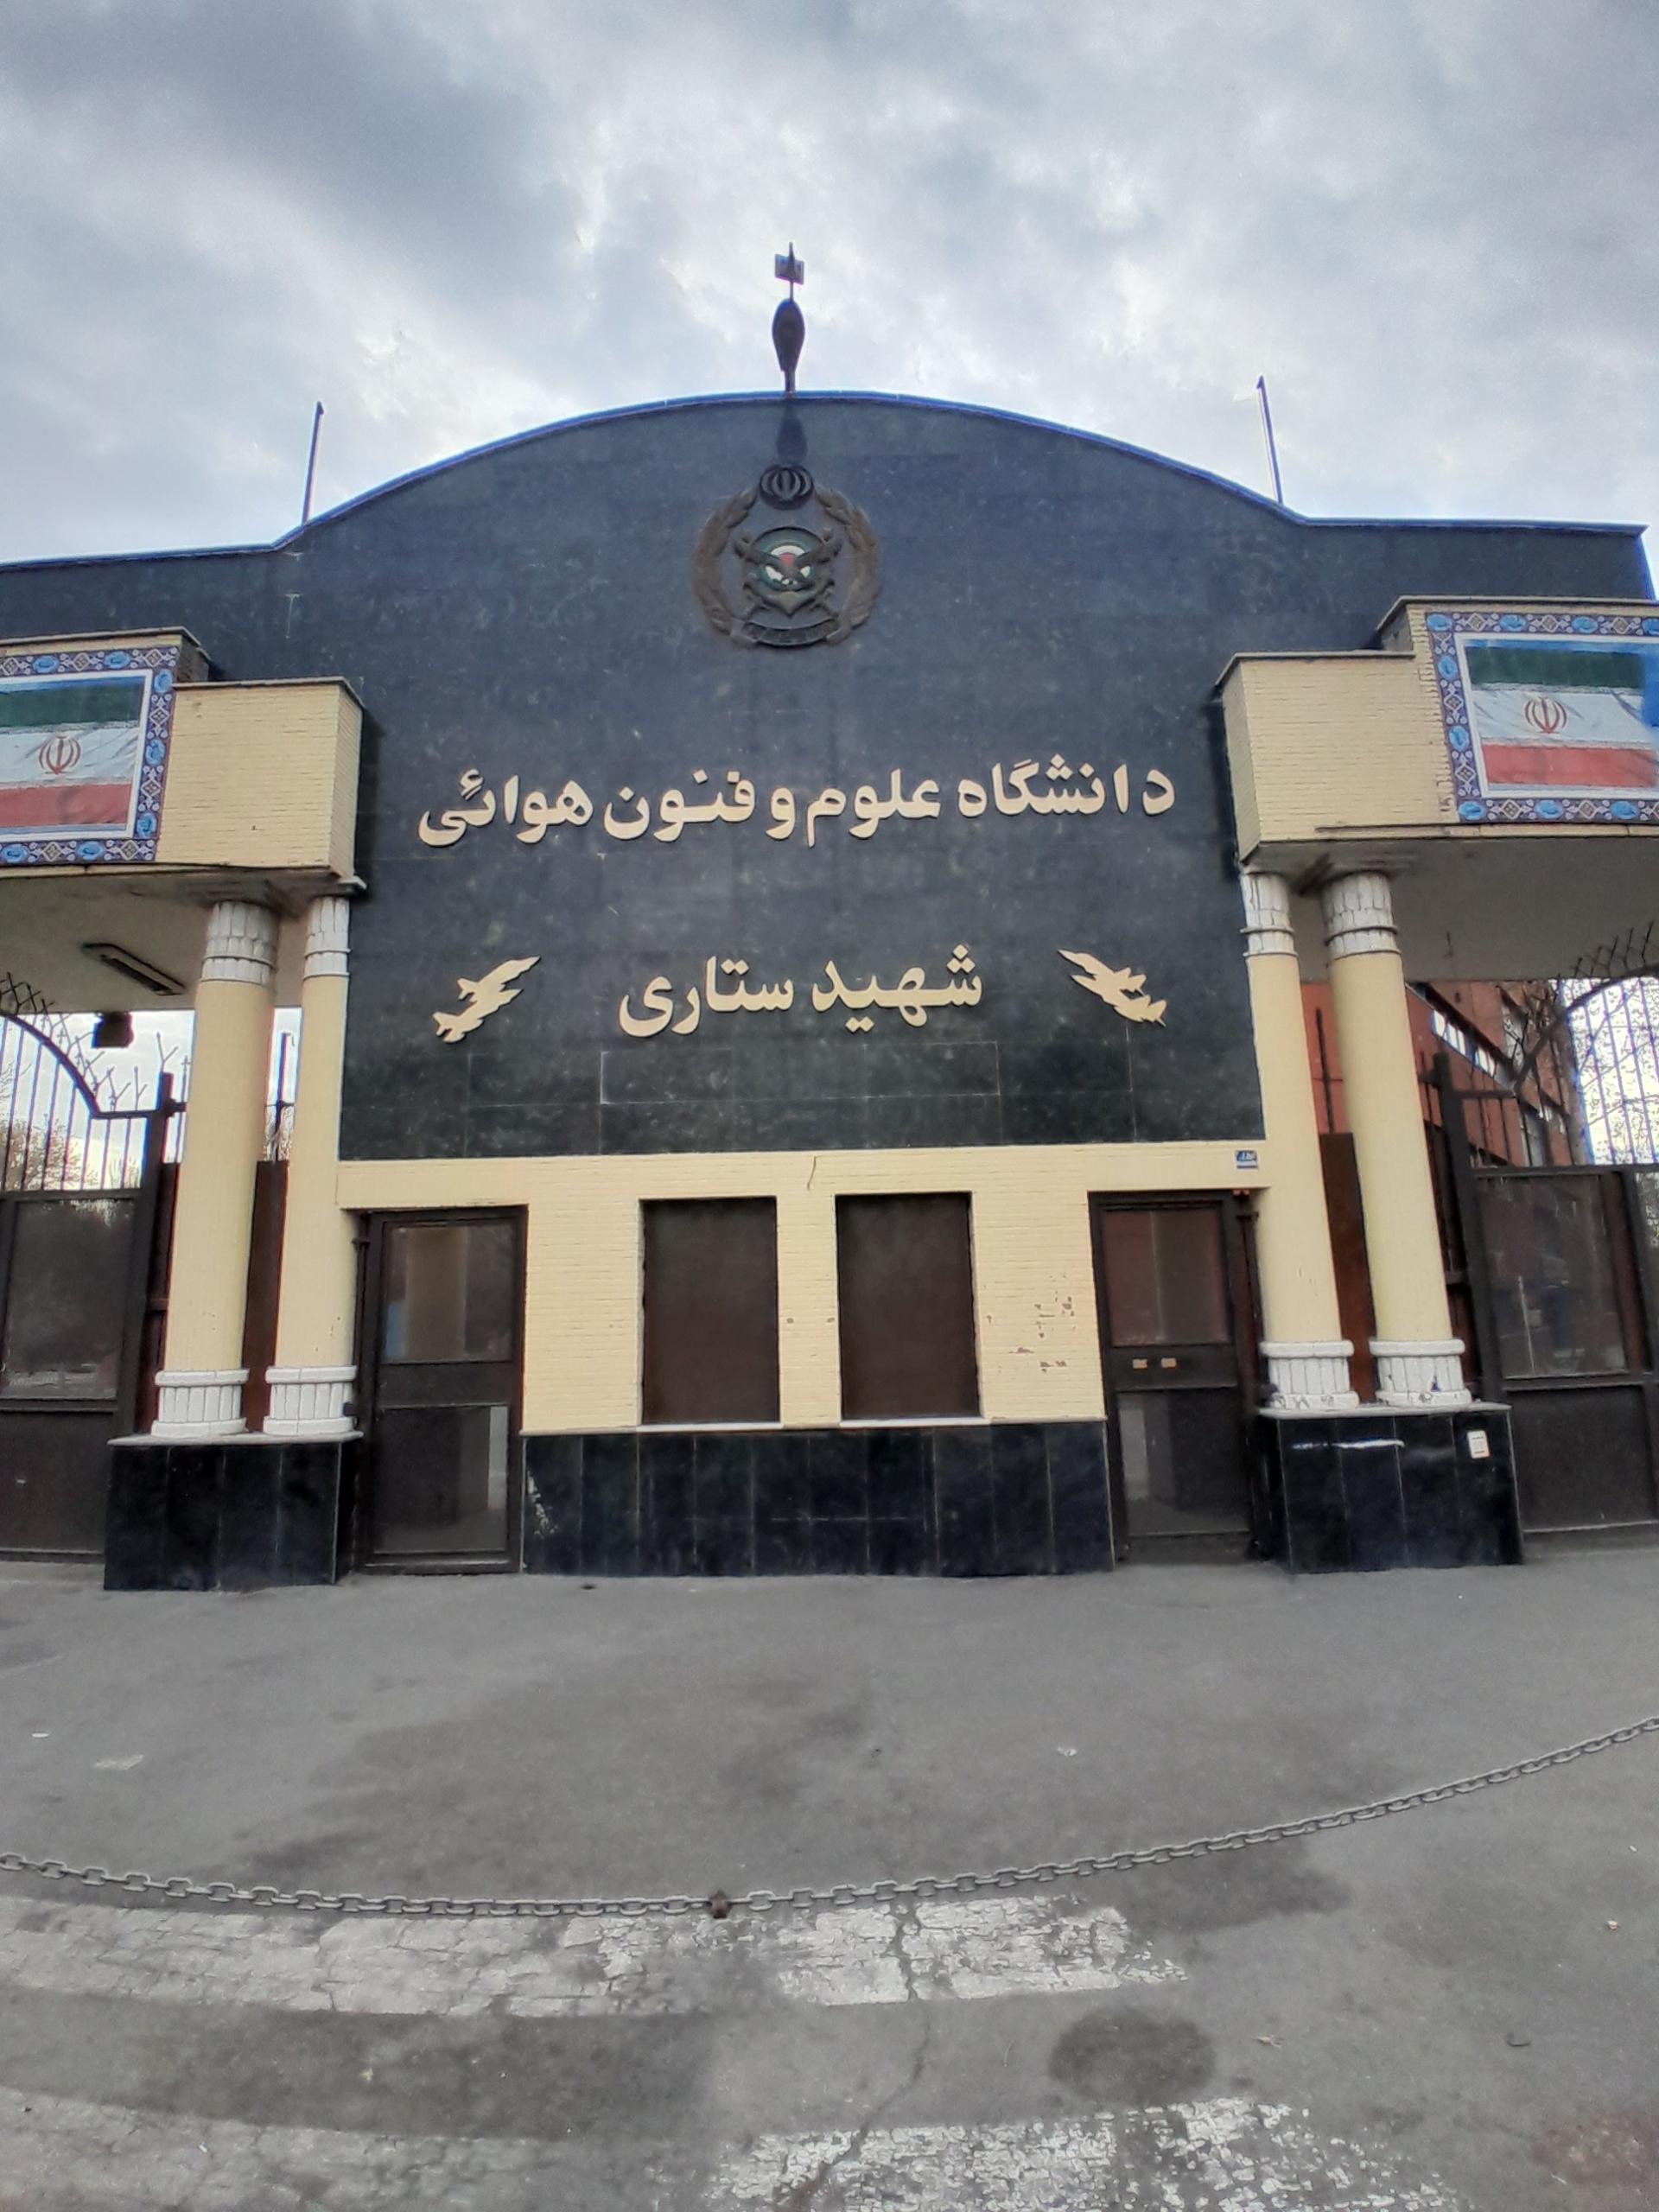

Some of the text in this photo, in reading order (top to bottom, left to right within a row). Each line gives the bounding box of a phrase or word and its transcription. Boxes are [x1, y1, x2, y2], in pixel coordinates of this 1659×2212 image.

[604, 769, 755, 842] فنون
[766, 787, 796, 839] و
[807, 768, 941, 847] علوم
[957, 753, 1175, 817] دانشگاه
[619, 944, 982, 1037] شهید ستاری
